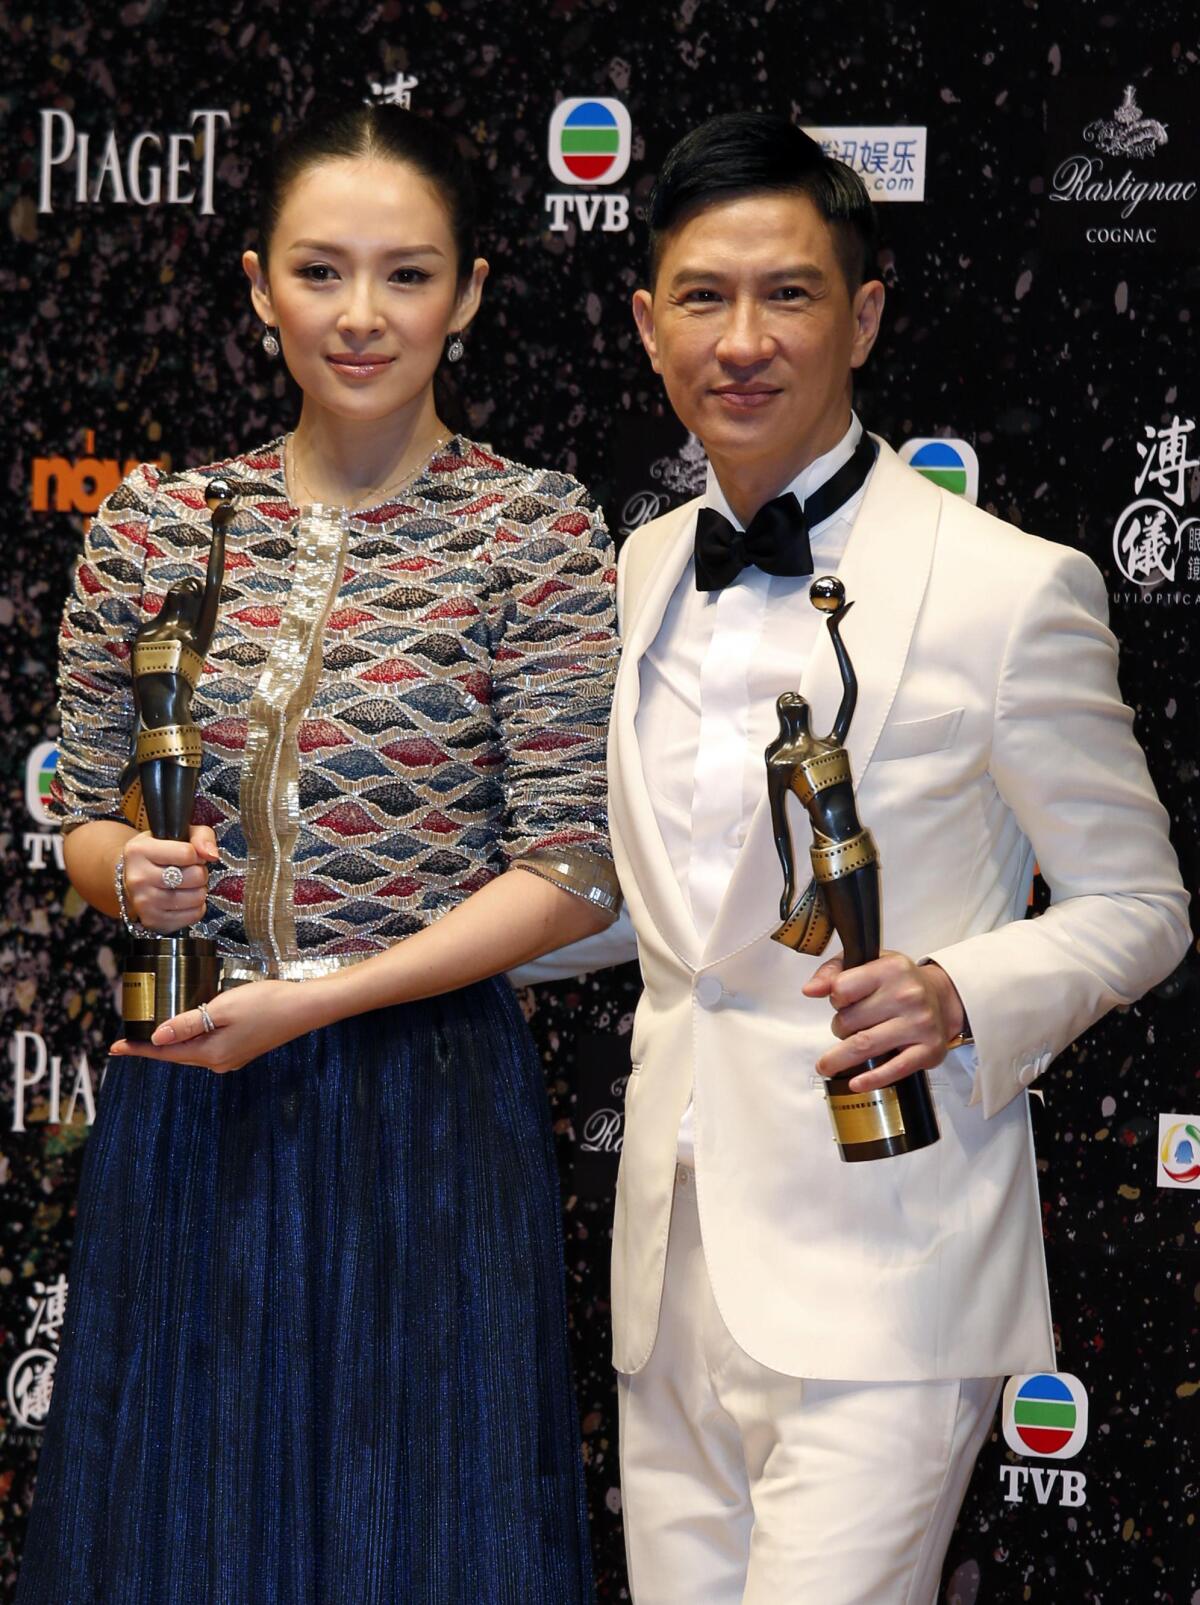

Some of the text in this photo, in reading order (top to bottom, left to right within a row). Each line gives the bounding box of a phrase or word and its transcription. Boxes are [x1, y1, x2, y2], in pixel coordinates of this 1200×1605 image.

[38, 108, 231, 214] PIAGET
[1049, 155, 1198, 219] Rastignac
[545, 194, 630, 232] TVB
[1086, 228, 1157, 243] COGNAC
[23, 833, 66, 870] TV
[11, 1030, 107, 1132] PIA
[1000, 1464, 1087, 1508] TVB
